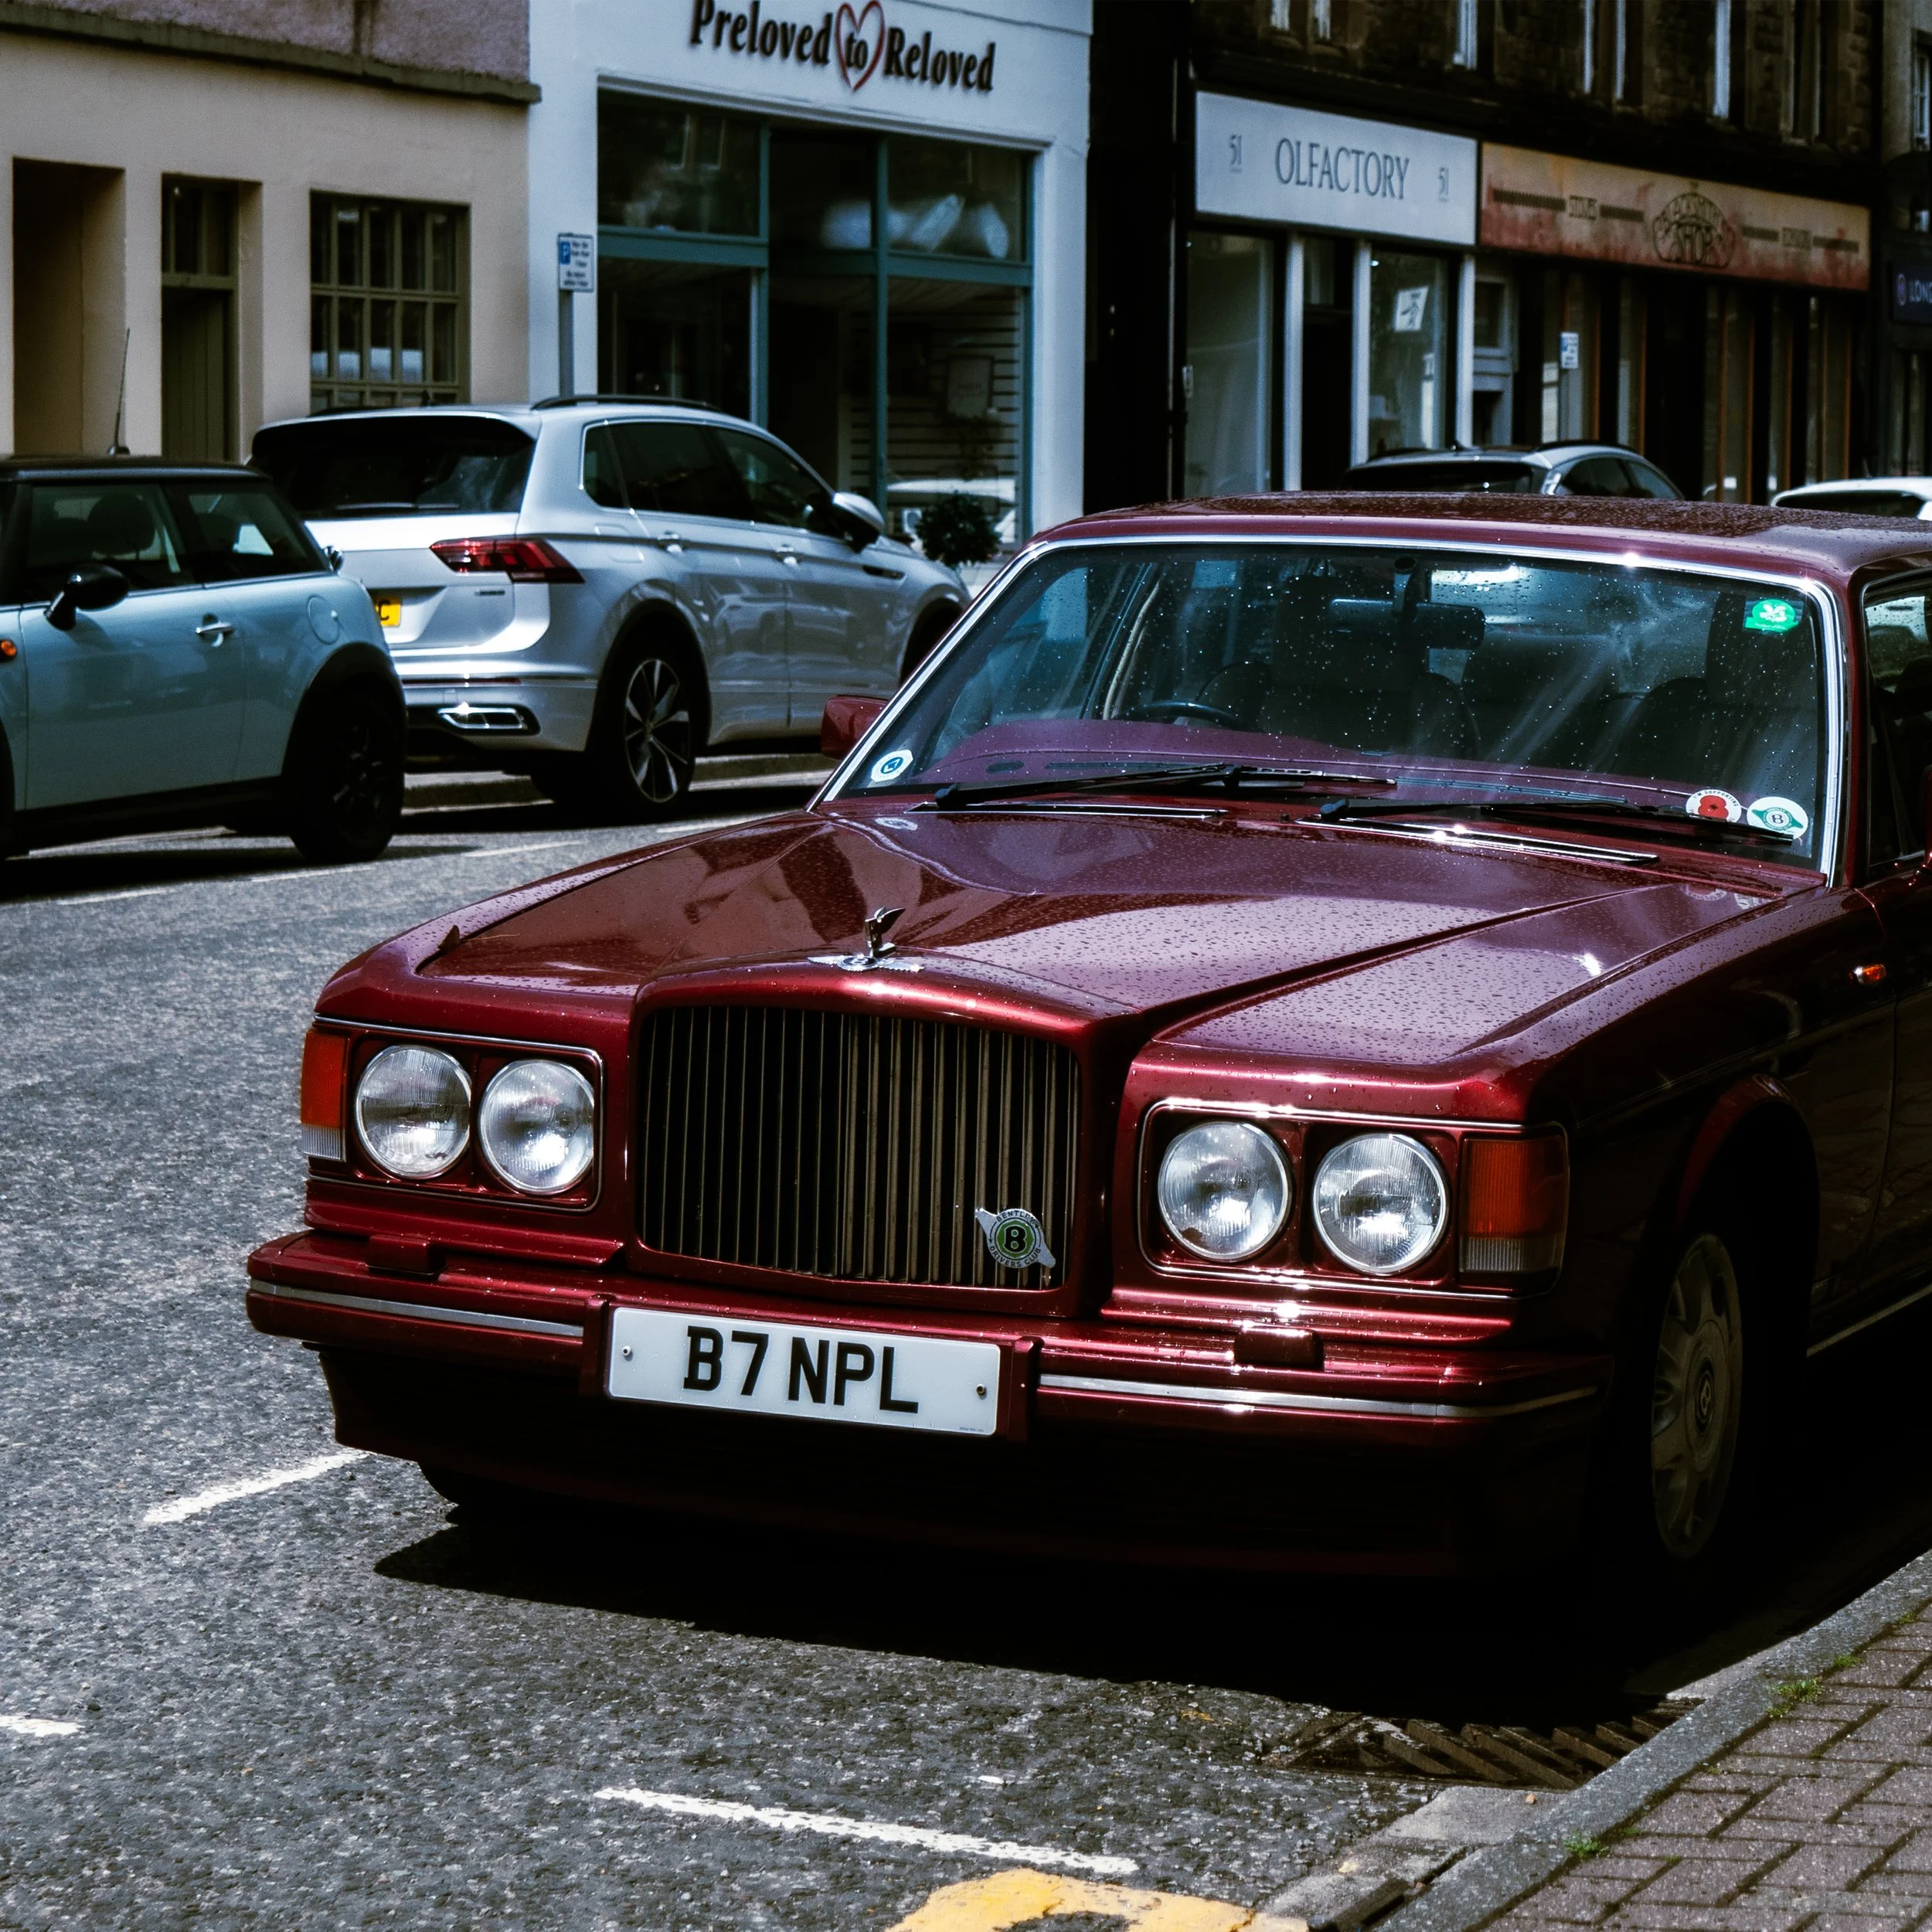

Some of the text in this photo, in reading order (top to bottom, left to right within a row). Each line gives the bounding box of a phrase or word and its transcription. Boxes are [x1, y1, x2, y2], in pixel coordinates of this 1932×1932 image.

[689, 0, 996, 91] Preloved to Reloved
[1276, 137, 1410, 199] OLFACTORY
[1703, 791, 1739, 807] SUPPORTING
[1771, 814, 1784, 825] B
[1004, 1226, 1027, 1253] B
[989, 1246, 1041, 1267] DRIVERS CLUB
[683, 1325, 919, 1413] B7 NPL
